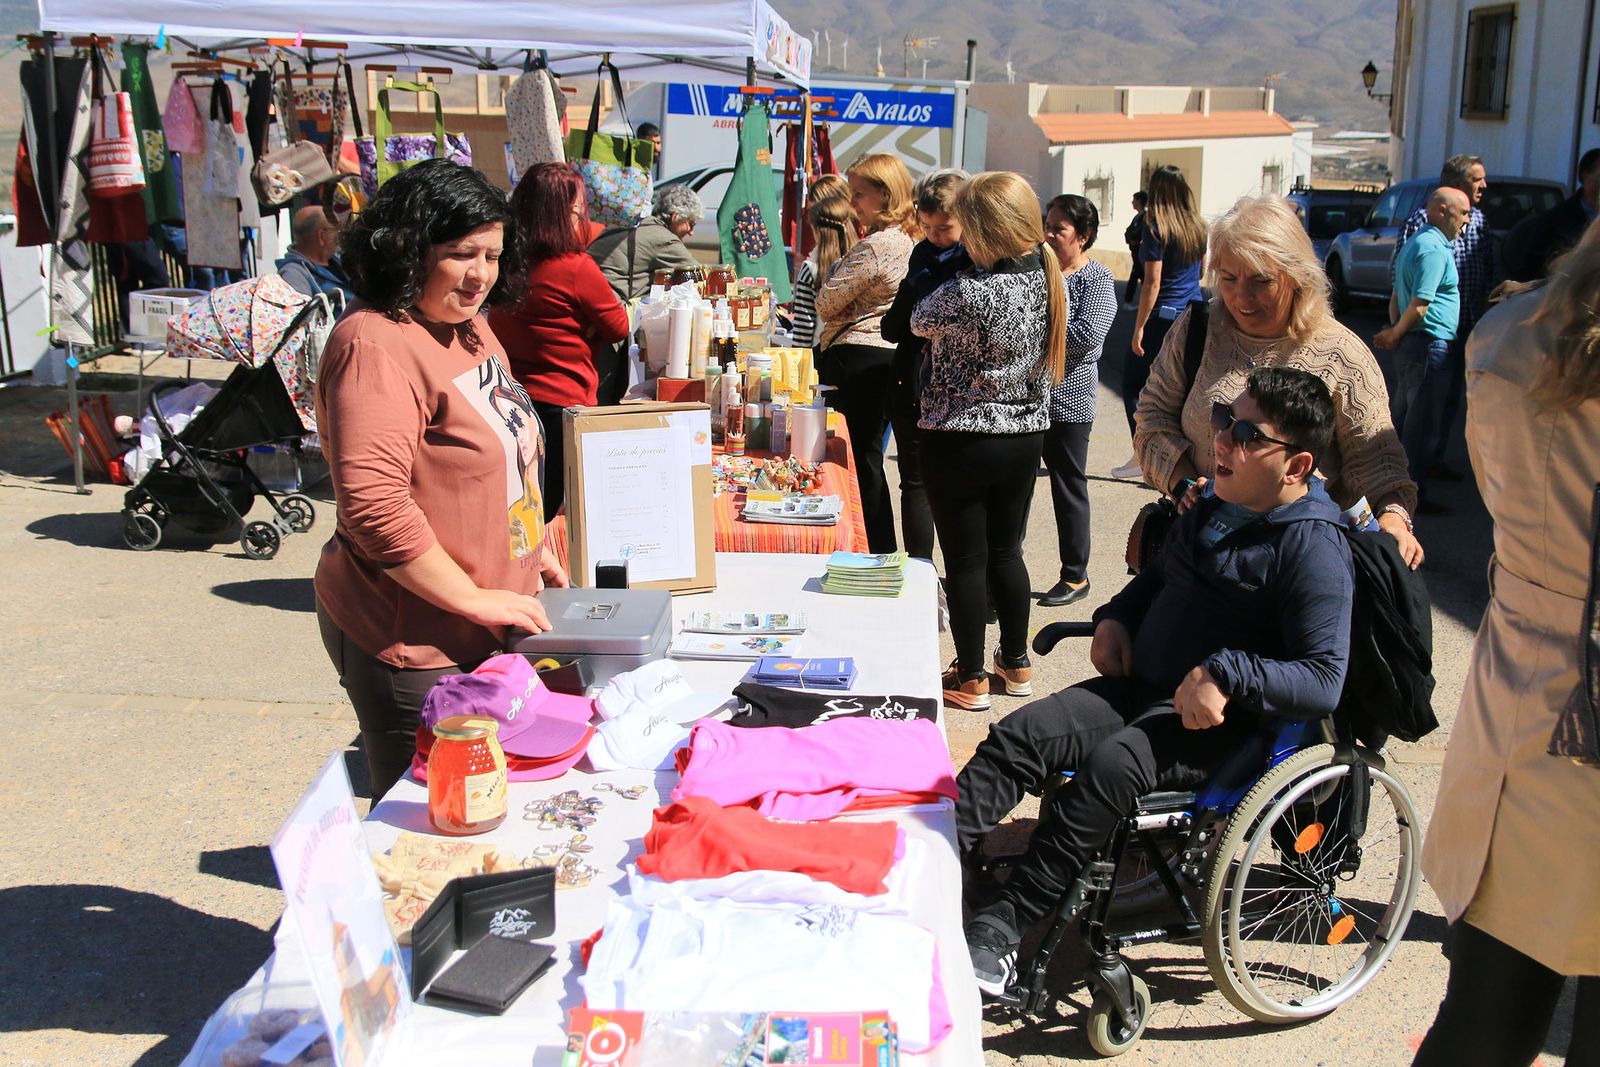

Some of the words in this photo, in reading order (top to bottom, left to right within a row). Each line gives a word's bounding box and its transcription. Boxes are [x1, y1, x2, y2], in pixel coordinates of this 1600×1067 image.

[843, 91, 933, 123] AVALOS
[607, 447, 627, 457] Lista
[630, 445, 639, 456] de
[639, 447, 667, 459] precios
